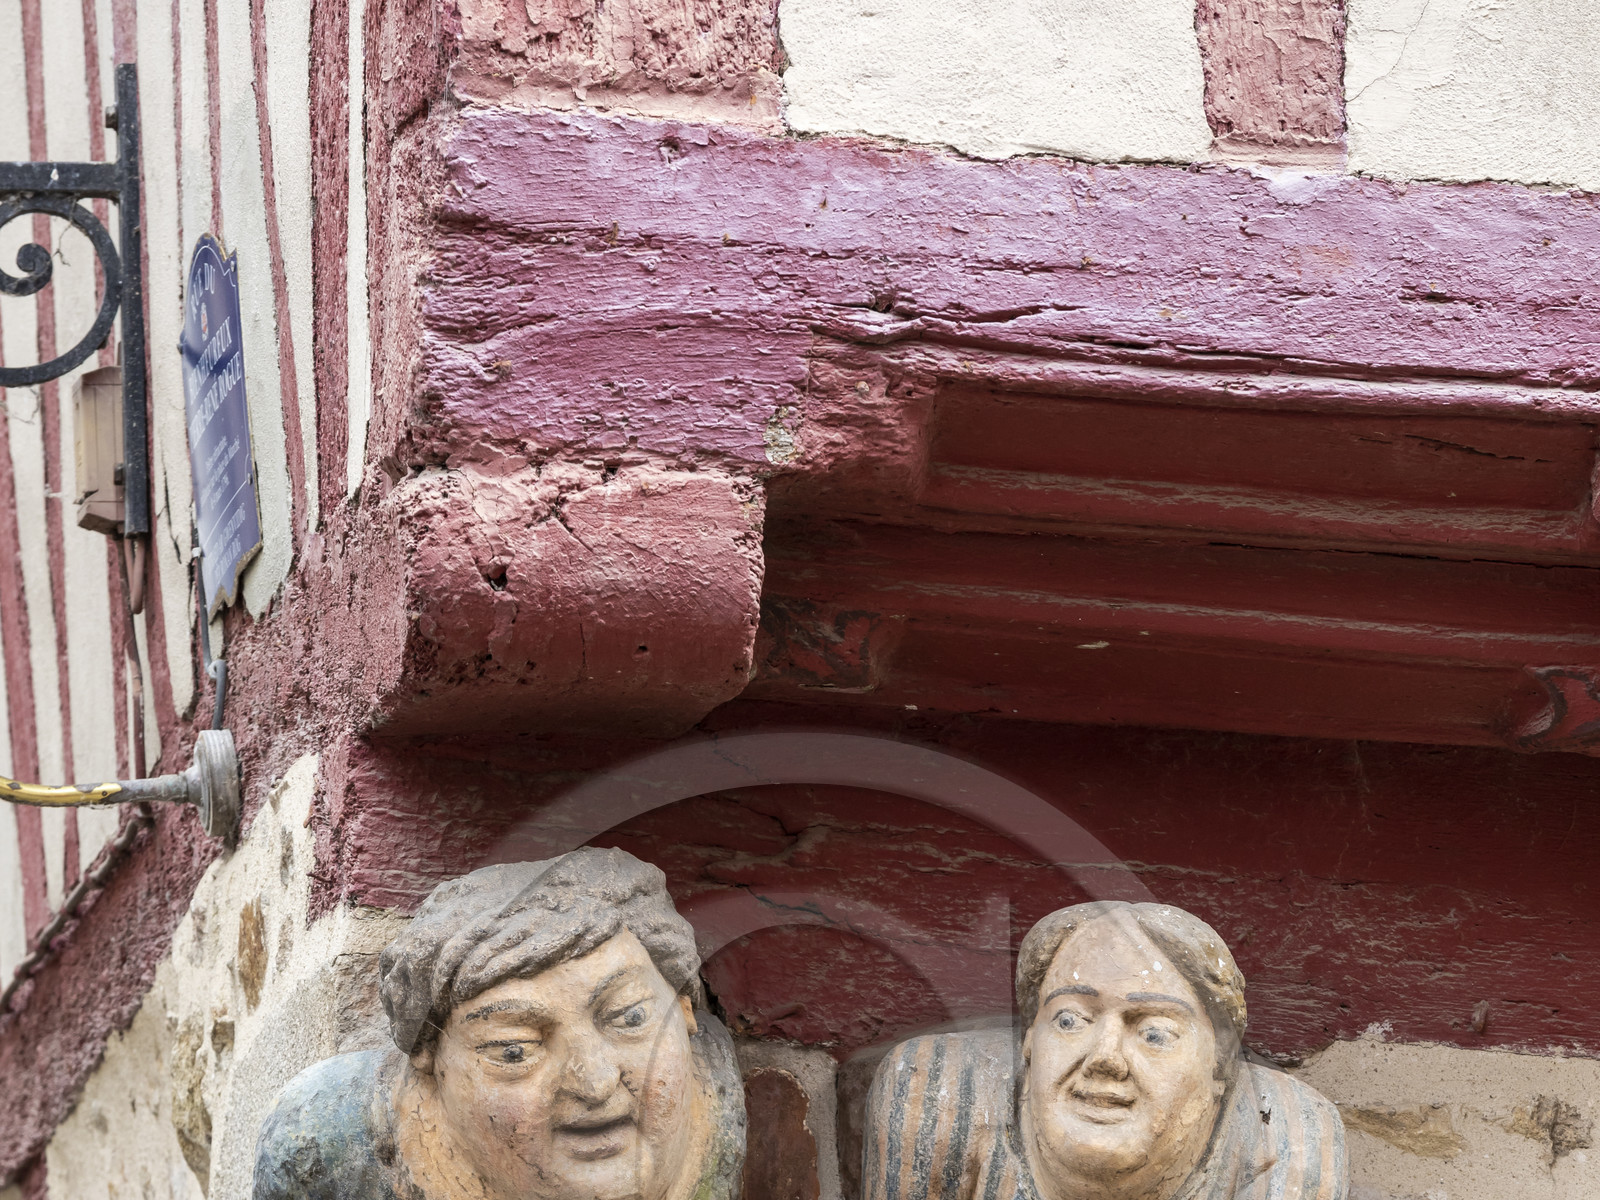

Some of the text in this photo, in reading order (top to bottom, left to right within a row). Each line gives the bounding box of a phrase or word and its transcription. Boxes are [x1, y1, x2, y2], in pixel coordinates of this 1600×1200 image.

[191, 262, 216, 323] RUE DU
[217, 351, 242, 404] ROGUE
